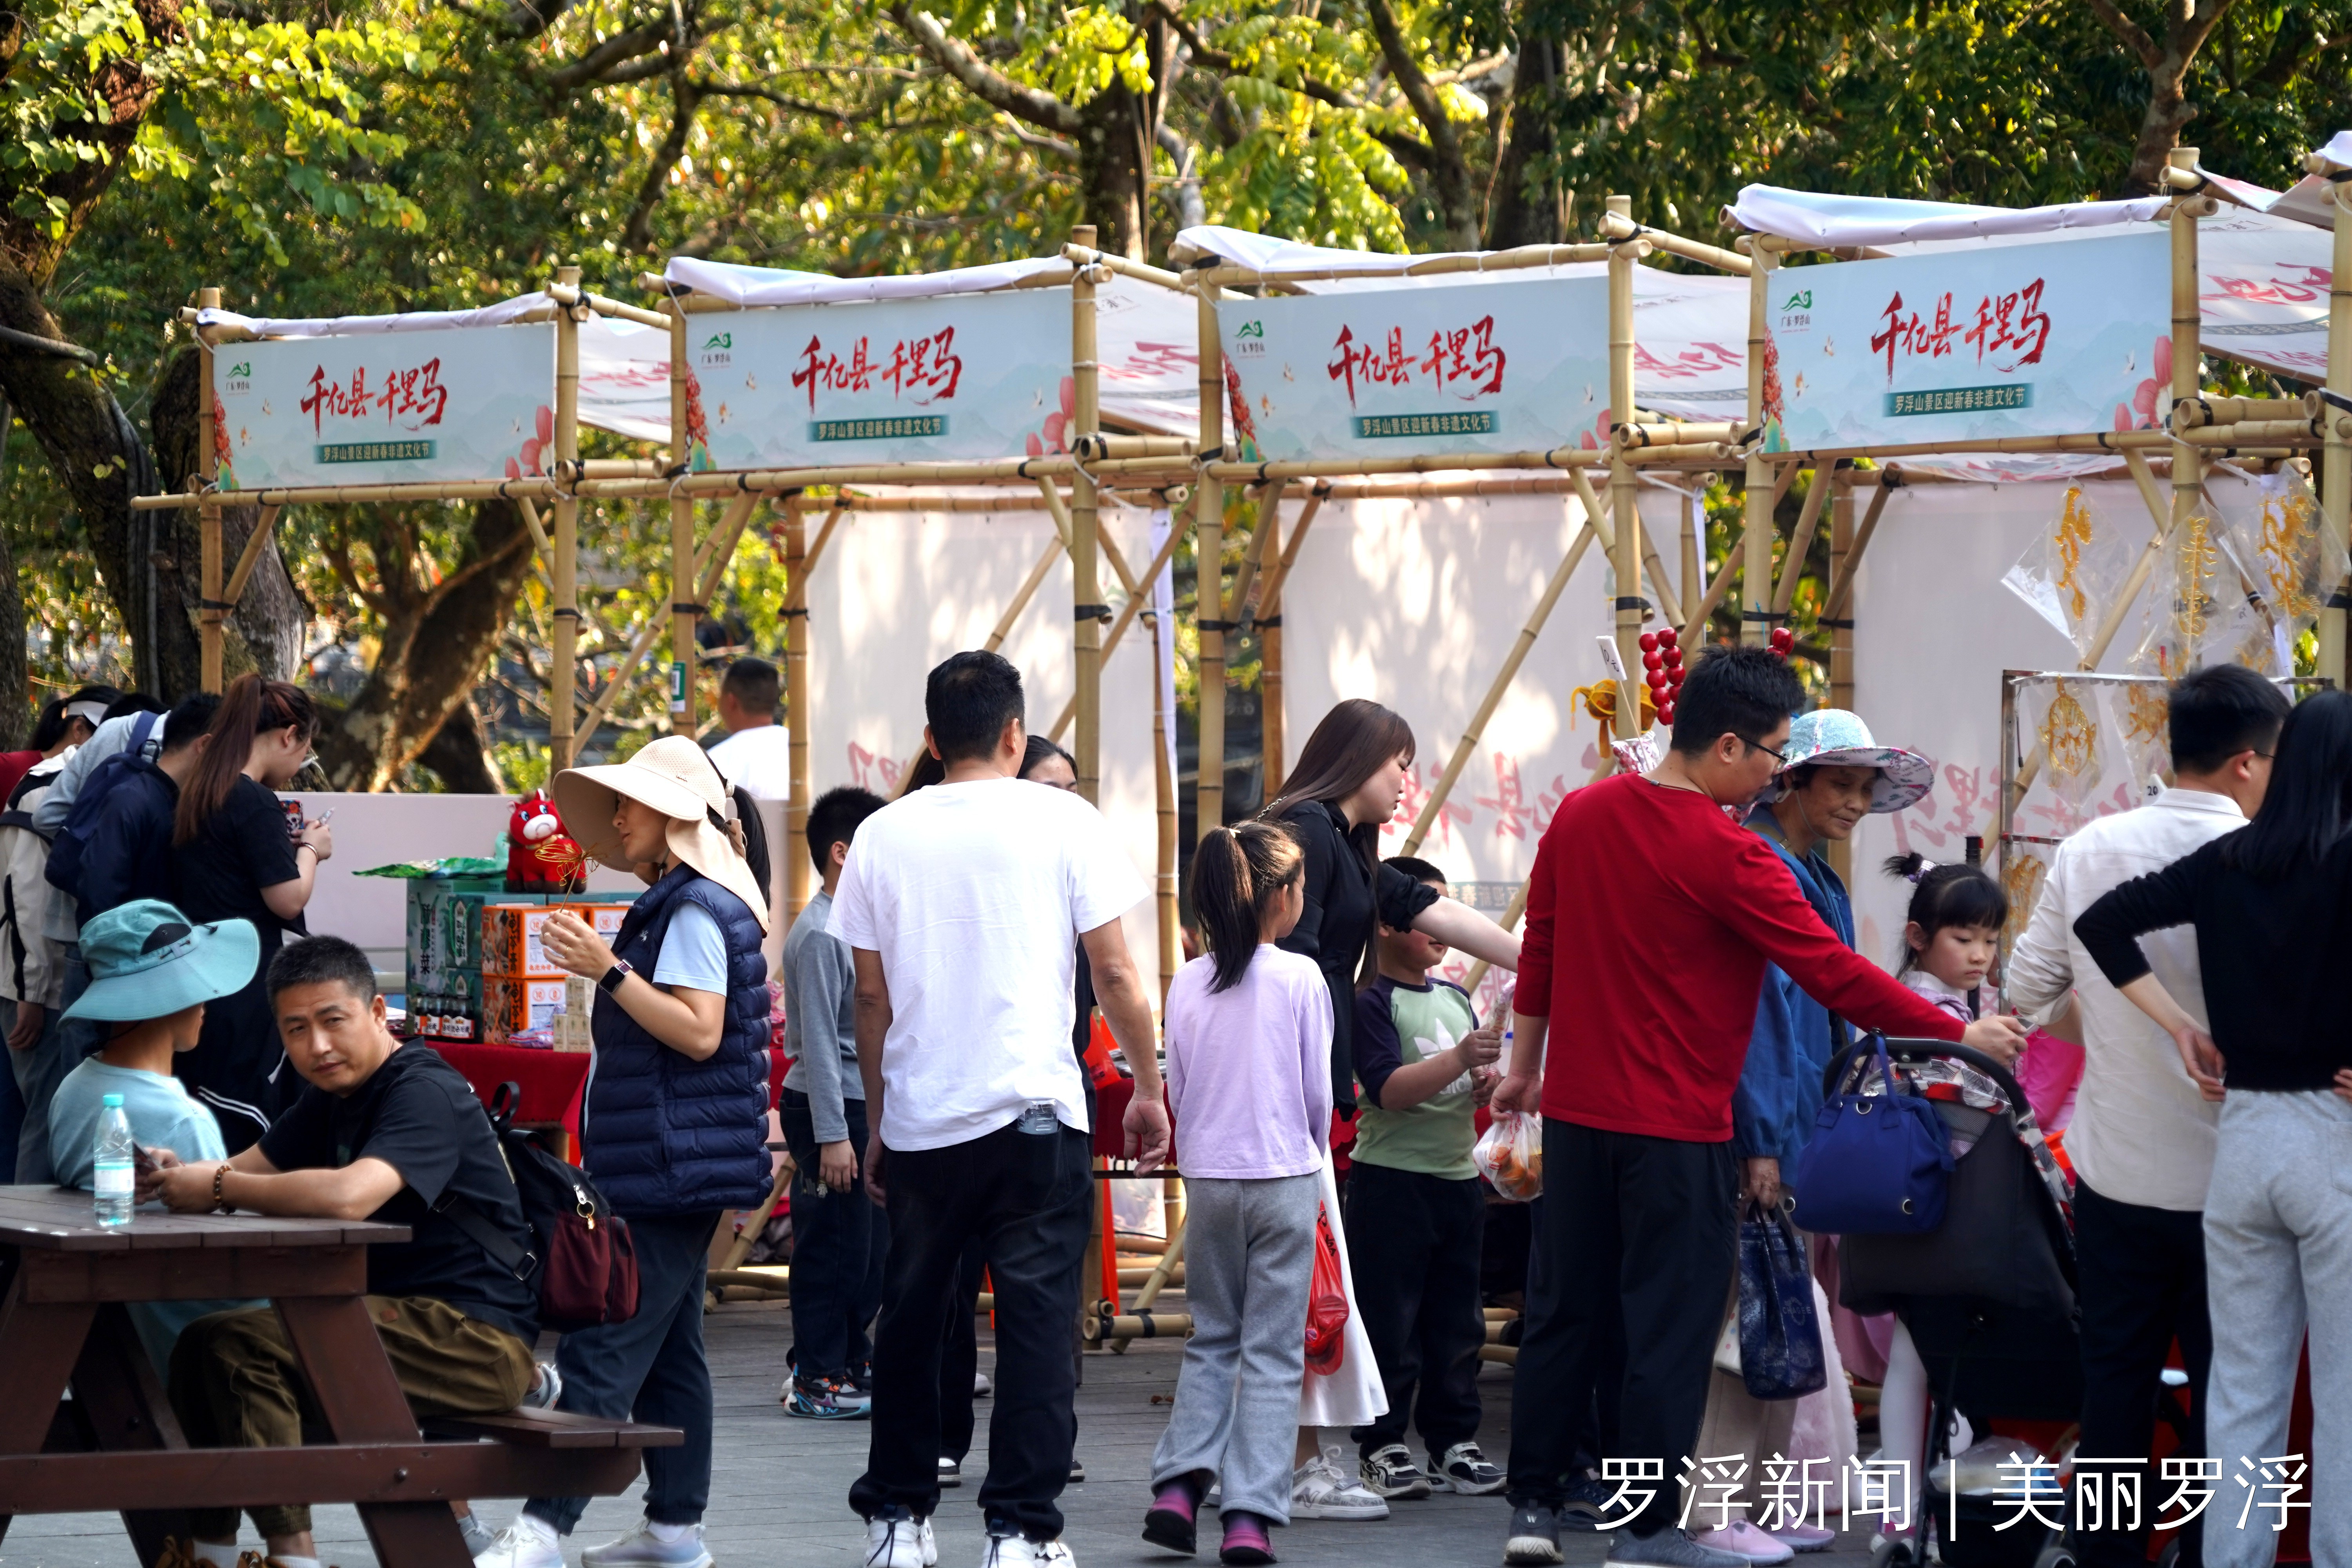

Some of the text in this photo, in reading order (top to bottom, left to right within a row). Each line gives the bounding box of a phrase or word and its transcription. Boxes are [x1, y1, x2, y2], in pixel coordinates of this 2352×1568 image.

[1895, 387, 2025, 414] 罗浮山景区迎新春非遗文化节
[818, 416, 942, 440] 罗浮山景区迎新春非遗文化节
[1362, 414, 1490, 436] 罗浮山景区迎新春非遗文化节
[323, 442, 430, 462] 罗浮山景区迎新春非遗文化节
[1782, 1306, 1812, 1314] CHAGEE
